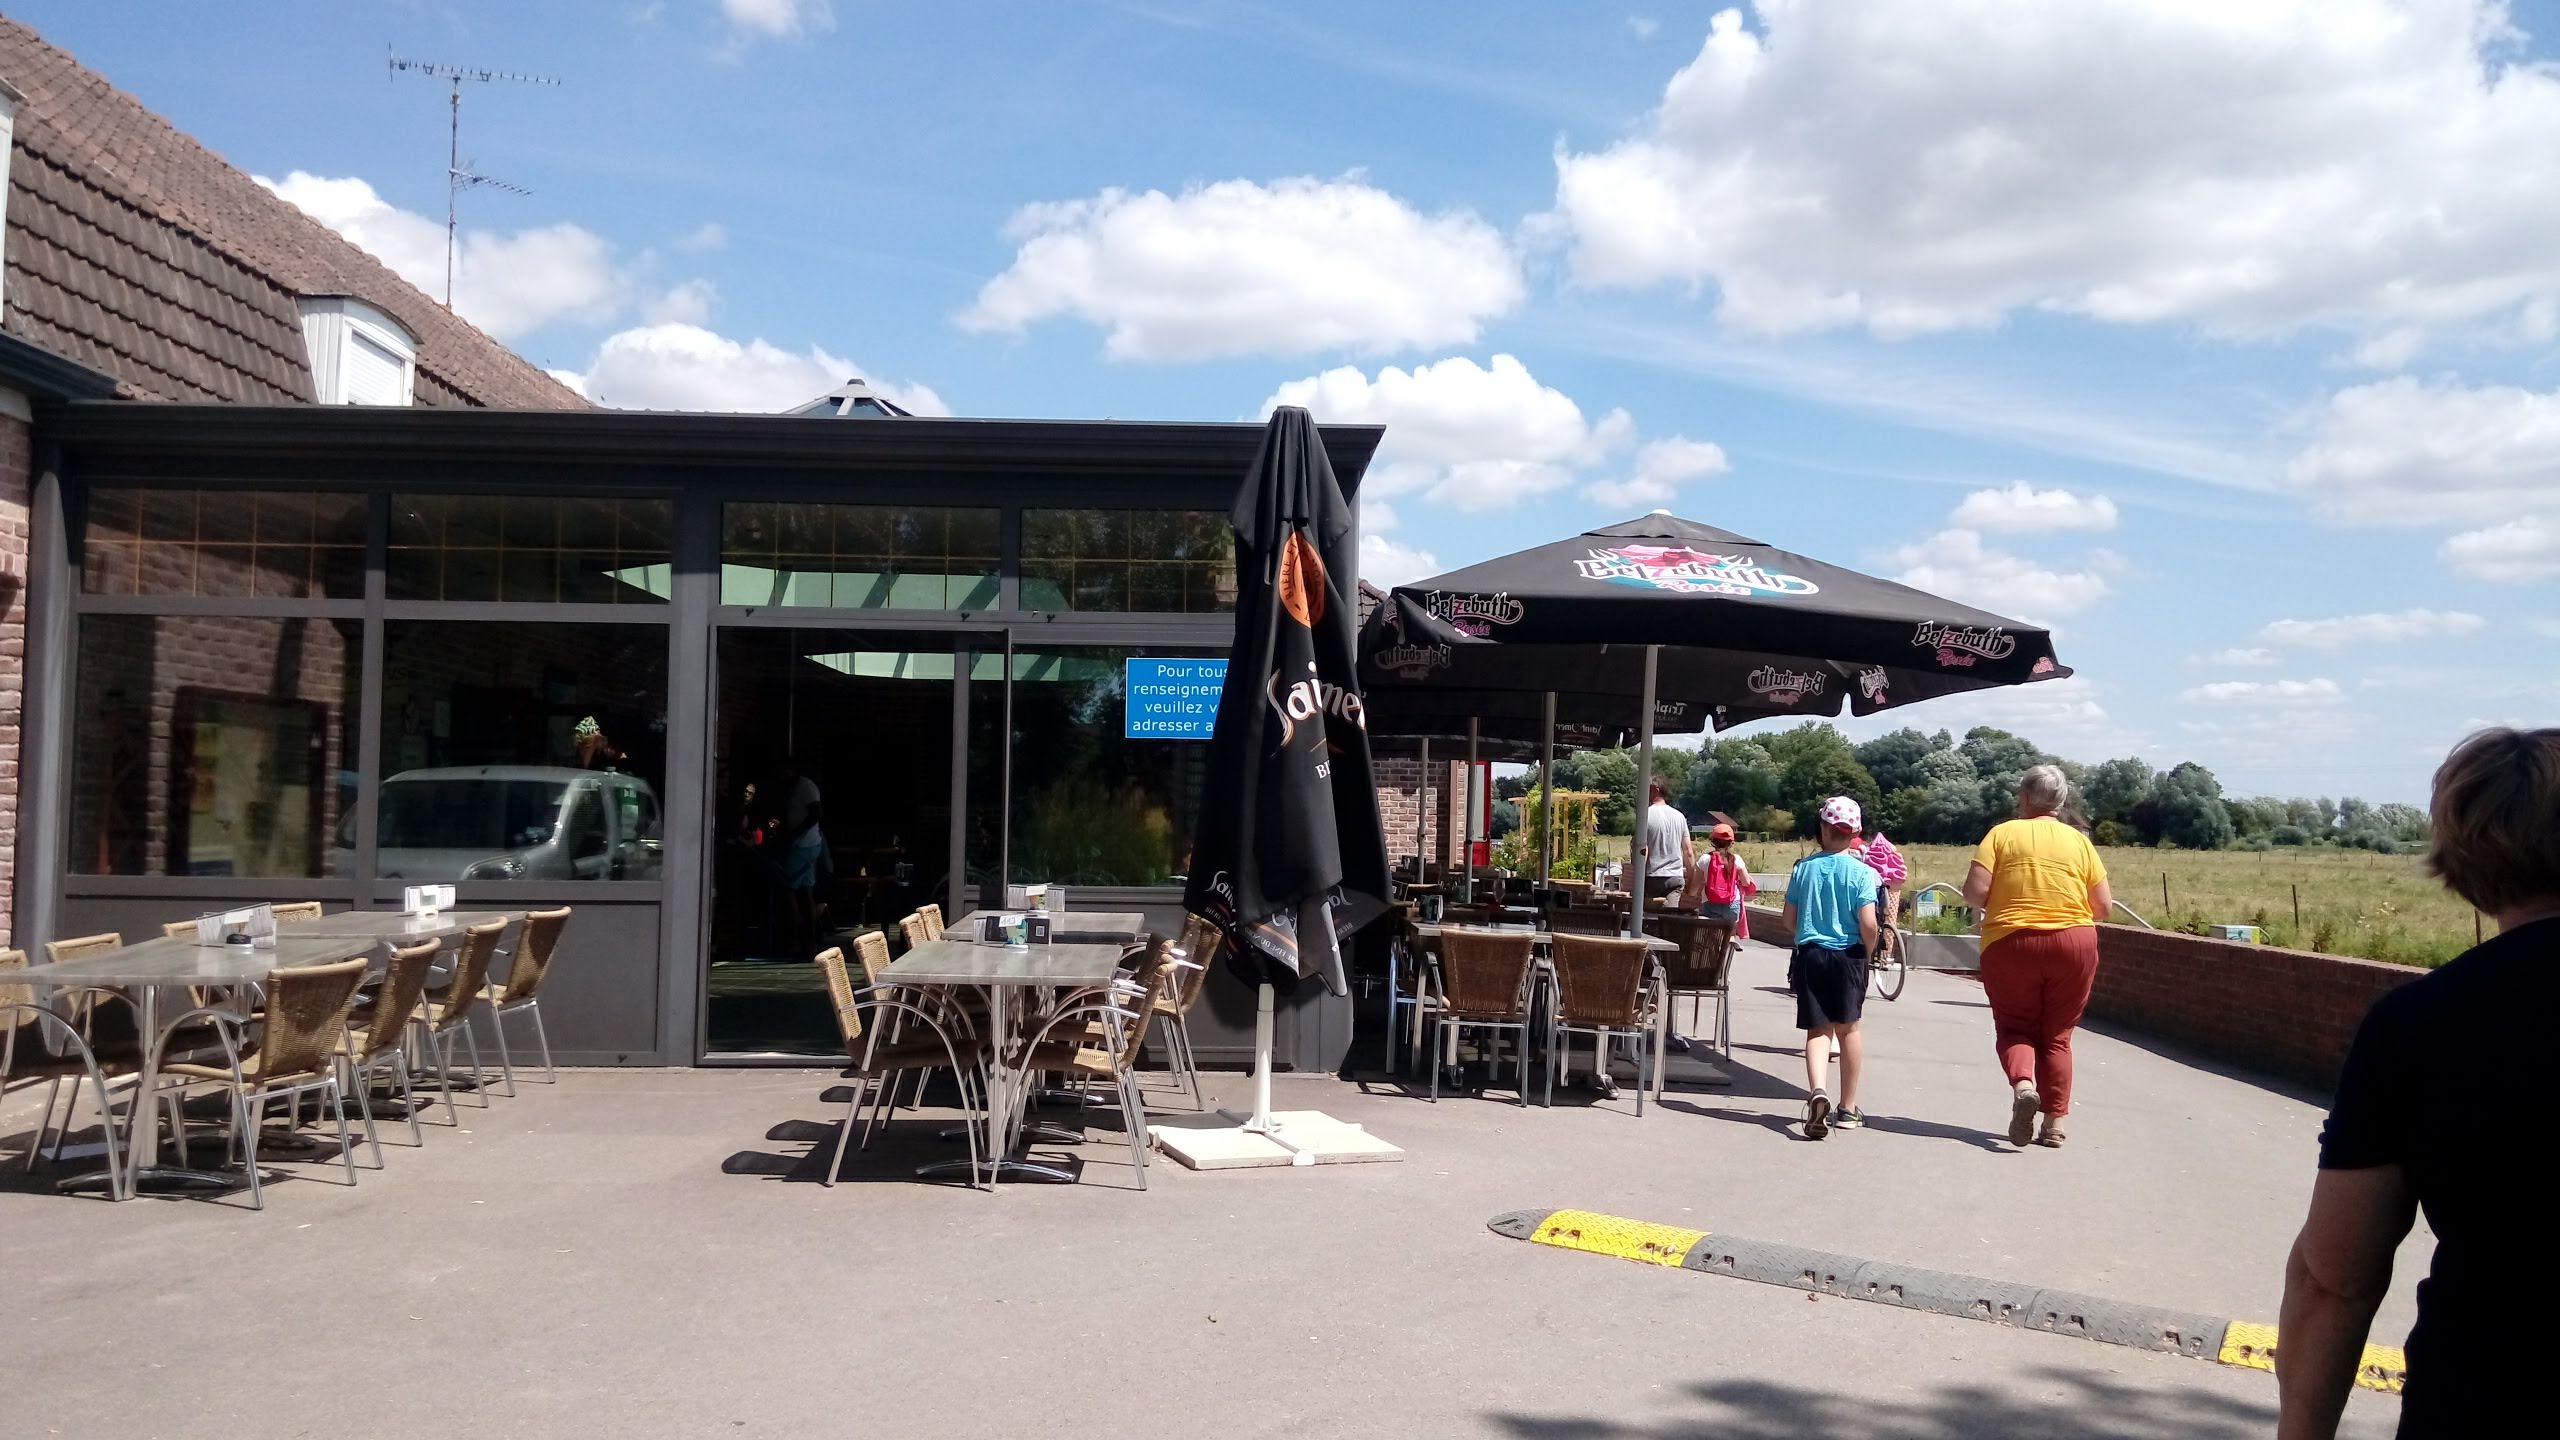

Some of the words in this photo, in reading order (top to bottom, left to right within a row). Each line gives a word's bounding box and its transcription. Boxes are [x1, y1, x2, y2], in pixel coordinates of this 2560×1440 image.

[1424, 589, 1524, 626] Belzebuth
[1912, 620, 2016, 660] Belzebuth
[1157, 664, 1193, 677] Pour
[1133, 682, 1223, 698] renseignem
[1144, 700, 1203, 714] veuillez
[1132, 718, 1200, 732] adresser
